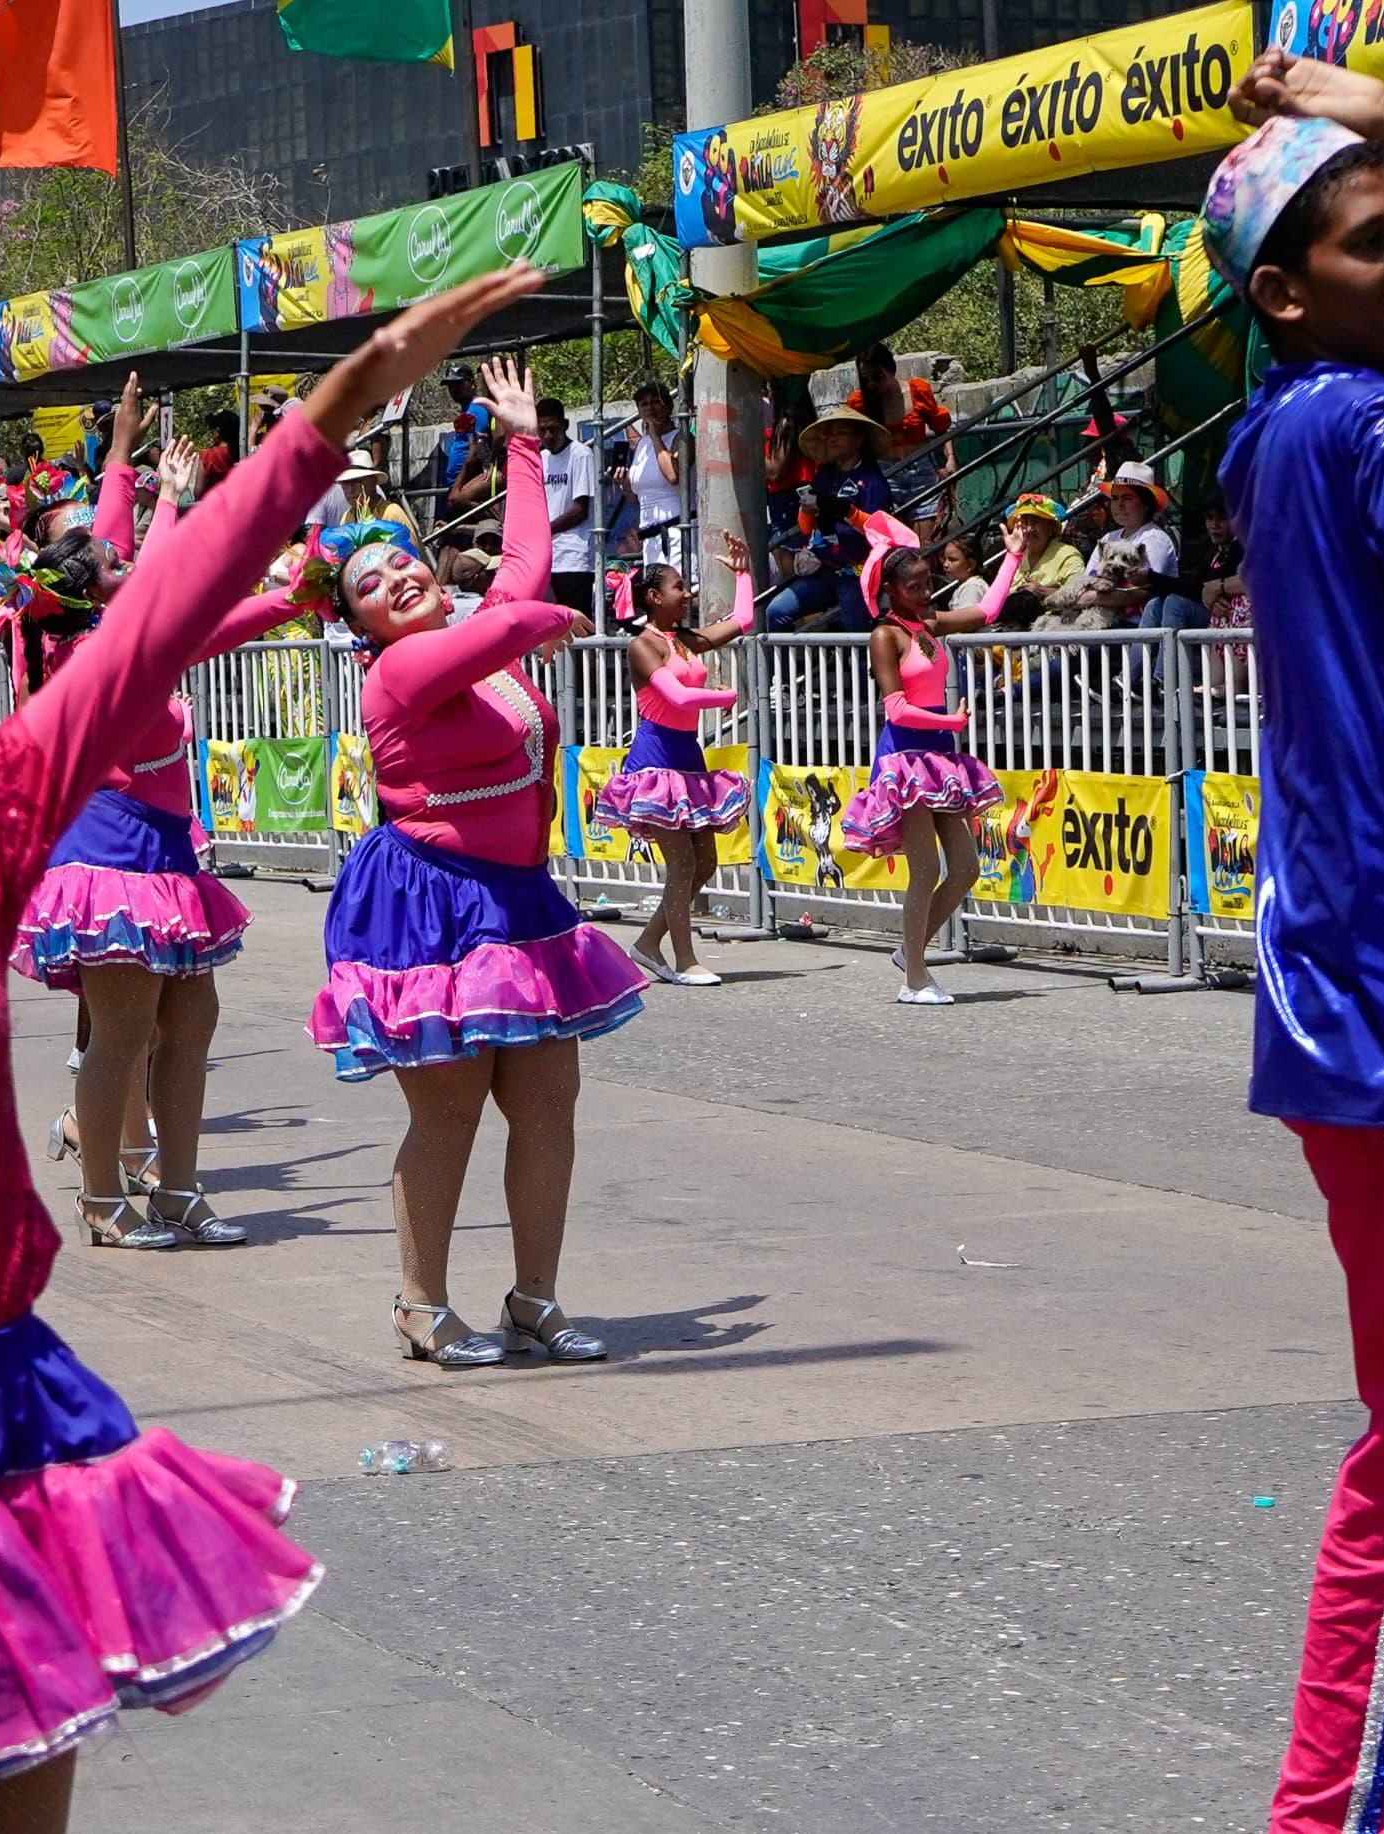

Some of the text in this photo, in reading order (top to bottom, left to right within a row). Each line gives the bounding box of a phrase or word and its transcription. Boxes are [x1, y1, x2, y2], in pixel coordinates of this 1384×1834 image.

[1001, 61, 1103, 161] éxito
[1121, 33, 1232, 141] éxito
[898, 89, 984, 185] éxito
[411, 223, 451, 262] Carulla
[499, 198, 543, 241] Carulla
[1062, 793, 1153, 896] éxito
